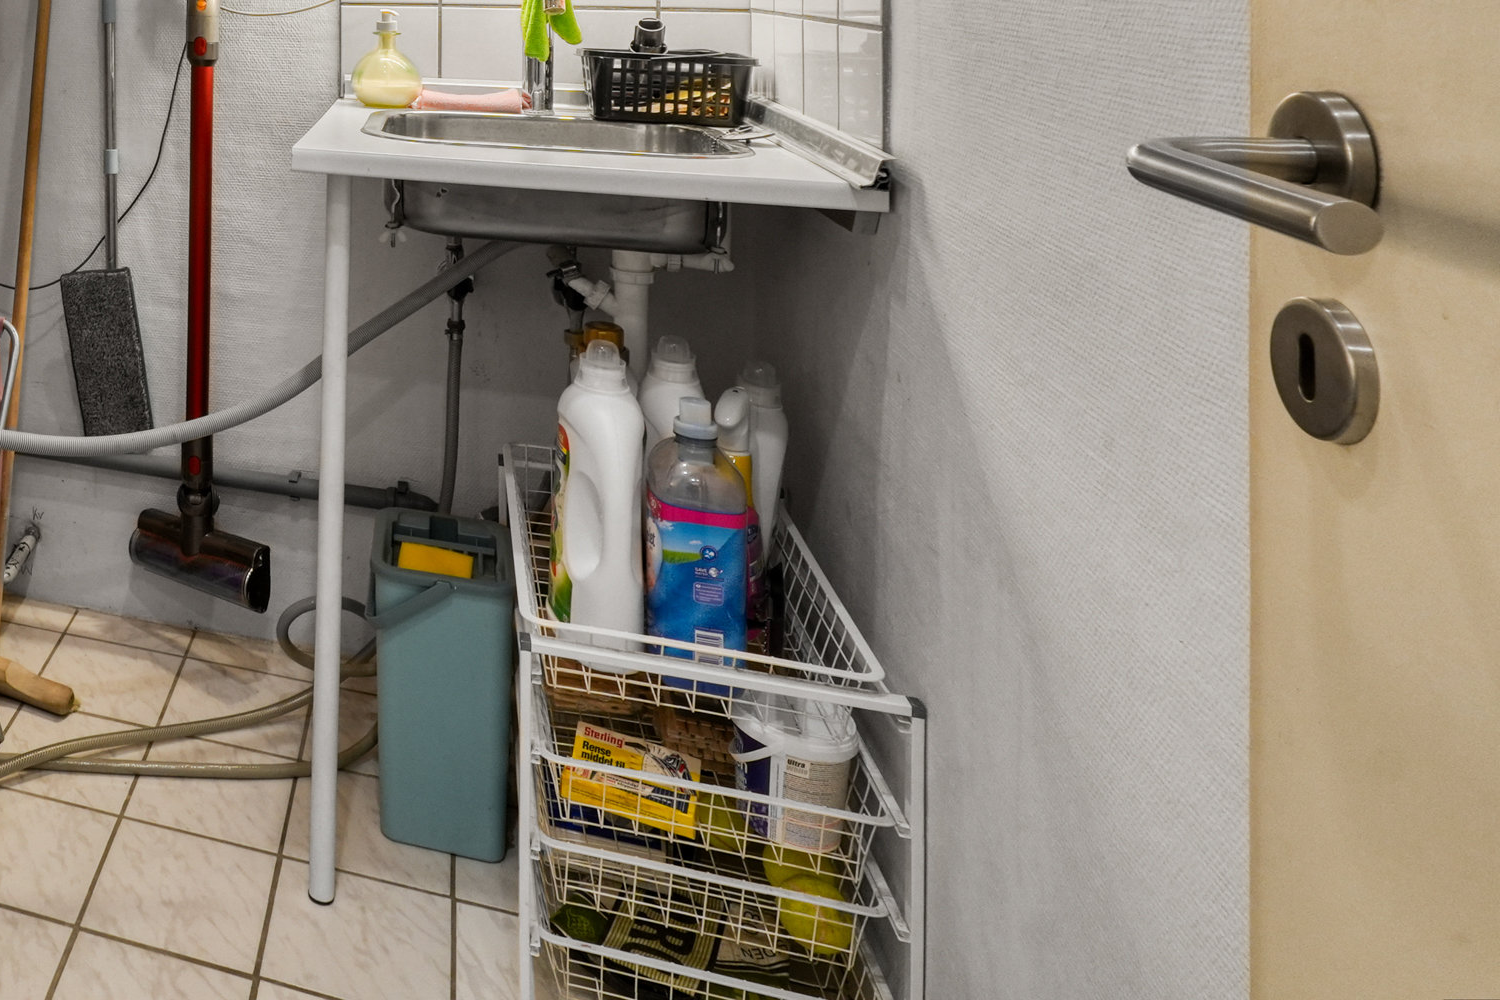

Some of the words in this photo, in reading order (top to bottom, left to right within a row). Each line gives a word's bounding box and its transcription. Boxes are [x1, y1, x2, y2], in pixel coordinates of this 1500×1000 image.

[584, 726, 624, 749] Sterling
[582, 740, 611, 757] Rense
[581, 751, 613, 767] middel
[616, 759, 626, 769] til
